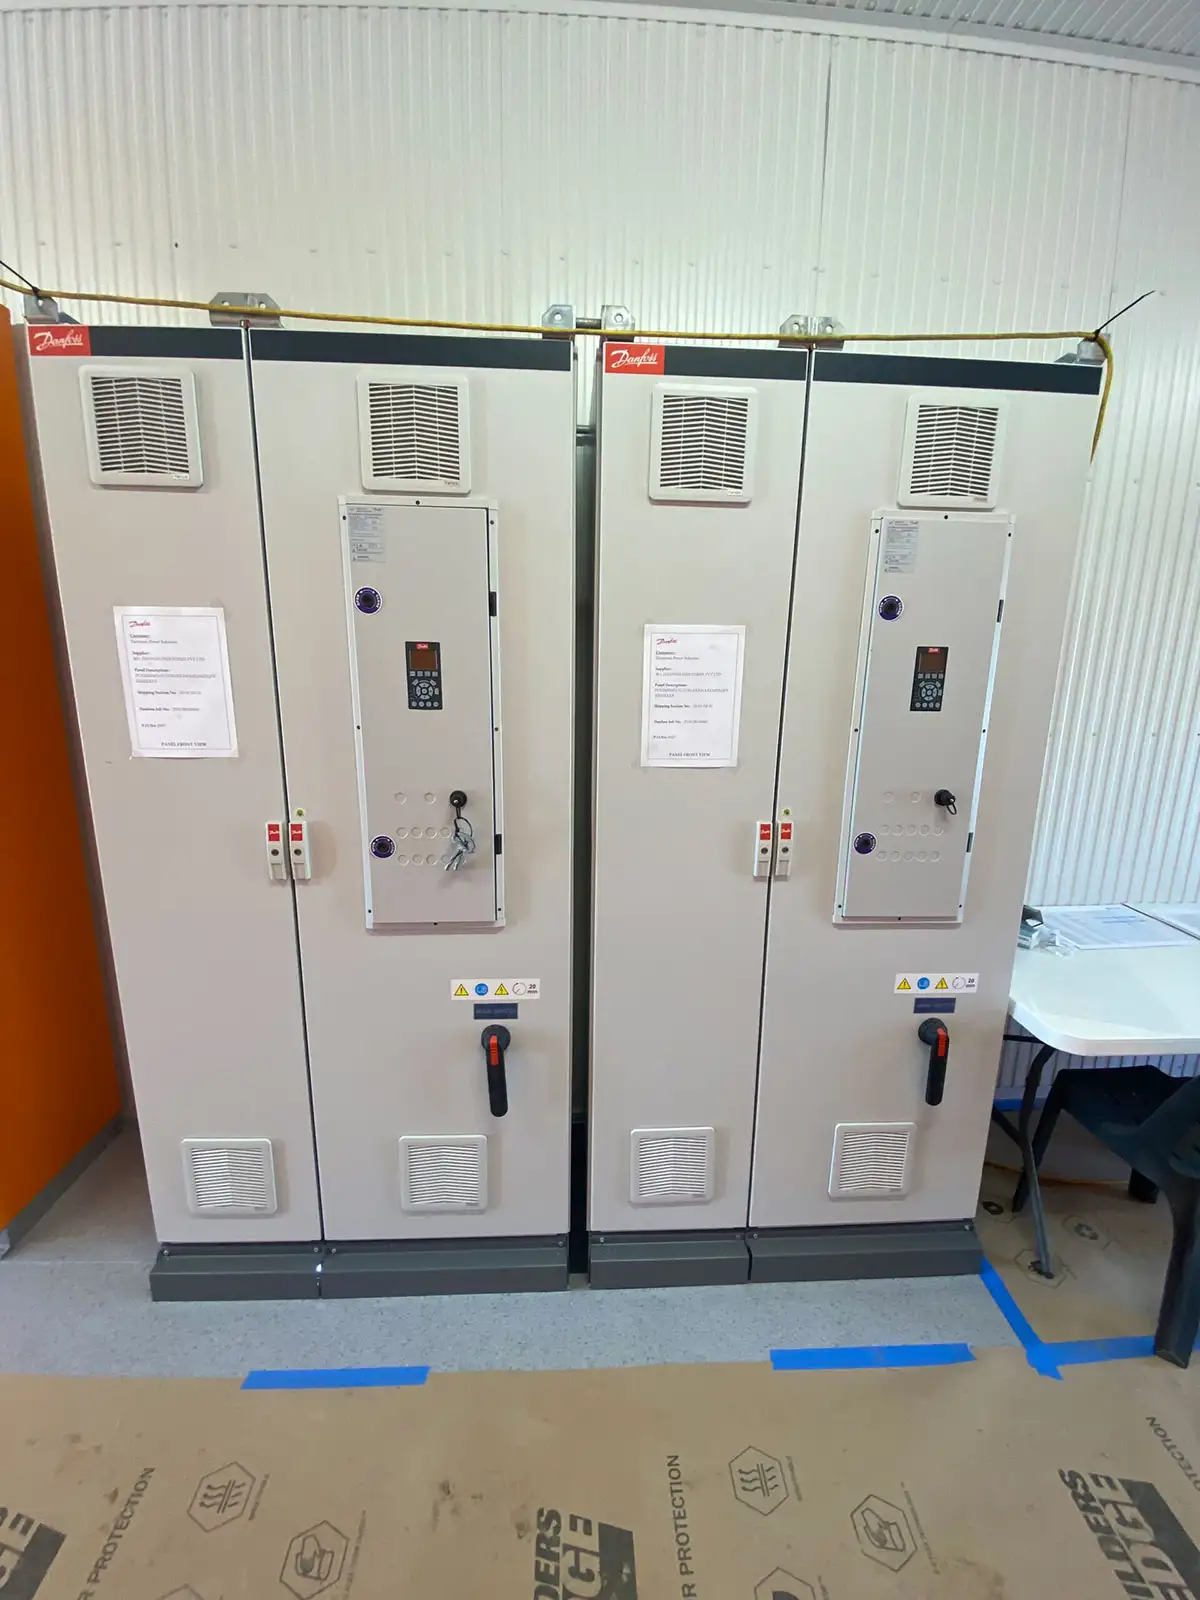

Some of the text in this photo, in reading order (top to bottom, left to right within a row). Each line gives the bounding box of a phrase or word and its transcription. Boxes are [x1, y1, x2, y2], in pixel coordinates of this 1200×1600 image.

[33, 329, 83, 351] Danfoss
[610, 347, 658, 368] Danfoss
[87, 1467, 156, 1584] PROTECTION
[666, 1454, 695, 1576] PROTECTION
